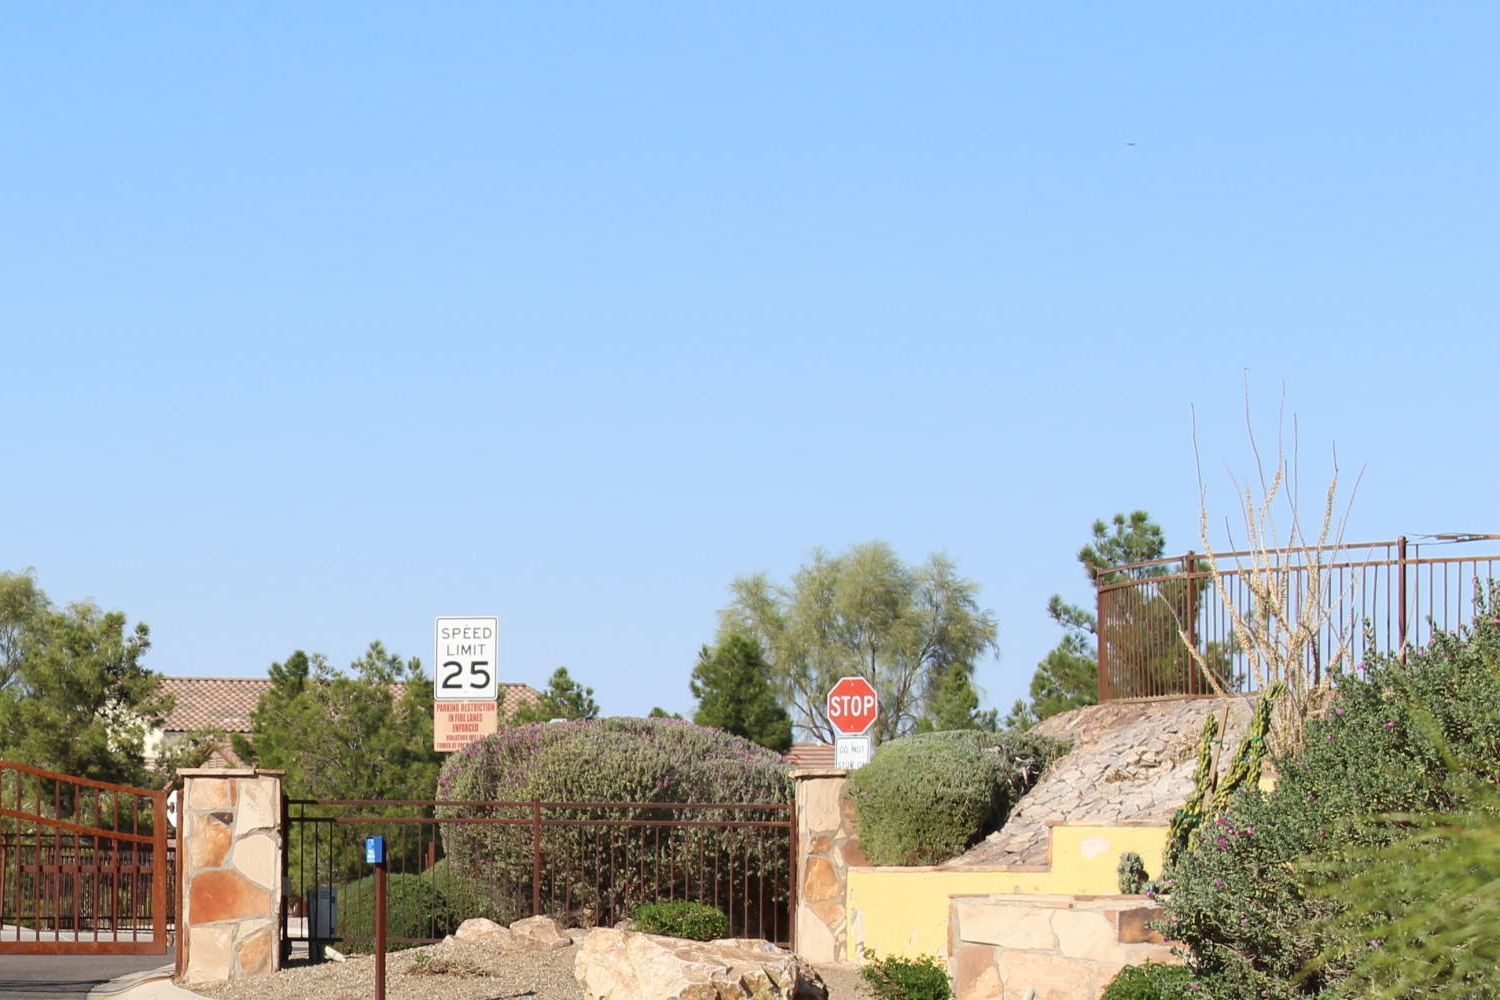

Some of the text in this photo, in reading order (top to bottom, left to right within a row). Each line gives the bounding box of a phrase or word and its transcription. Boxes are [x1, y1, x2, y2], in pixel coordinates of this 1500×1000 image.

[441, 627, 492, 640] SPEED
[446, 644, 486, 656] LIMIT
[442, 661, 490, 689] 25
[436, 703, 495, 712] PARKING RESTRICTION
[830, 695, 874, 717] STOP
[448, 713, 483, 722] IN FIRE LANES
[452, 723, 479, 733] ENFORCED
[839, 745, 865, 754] DO NOT
